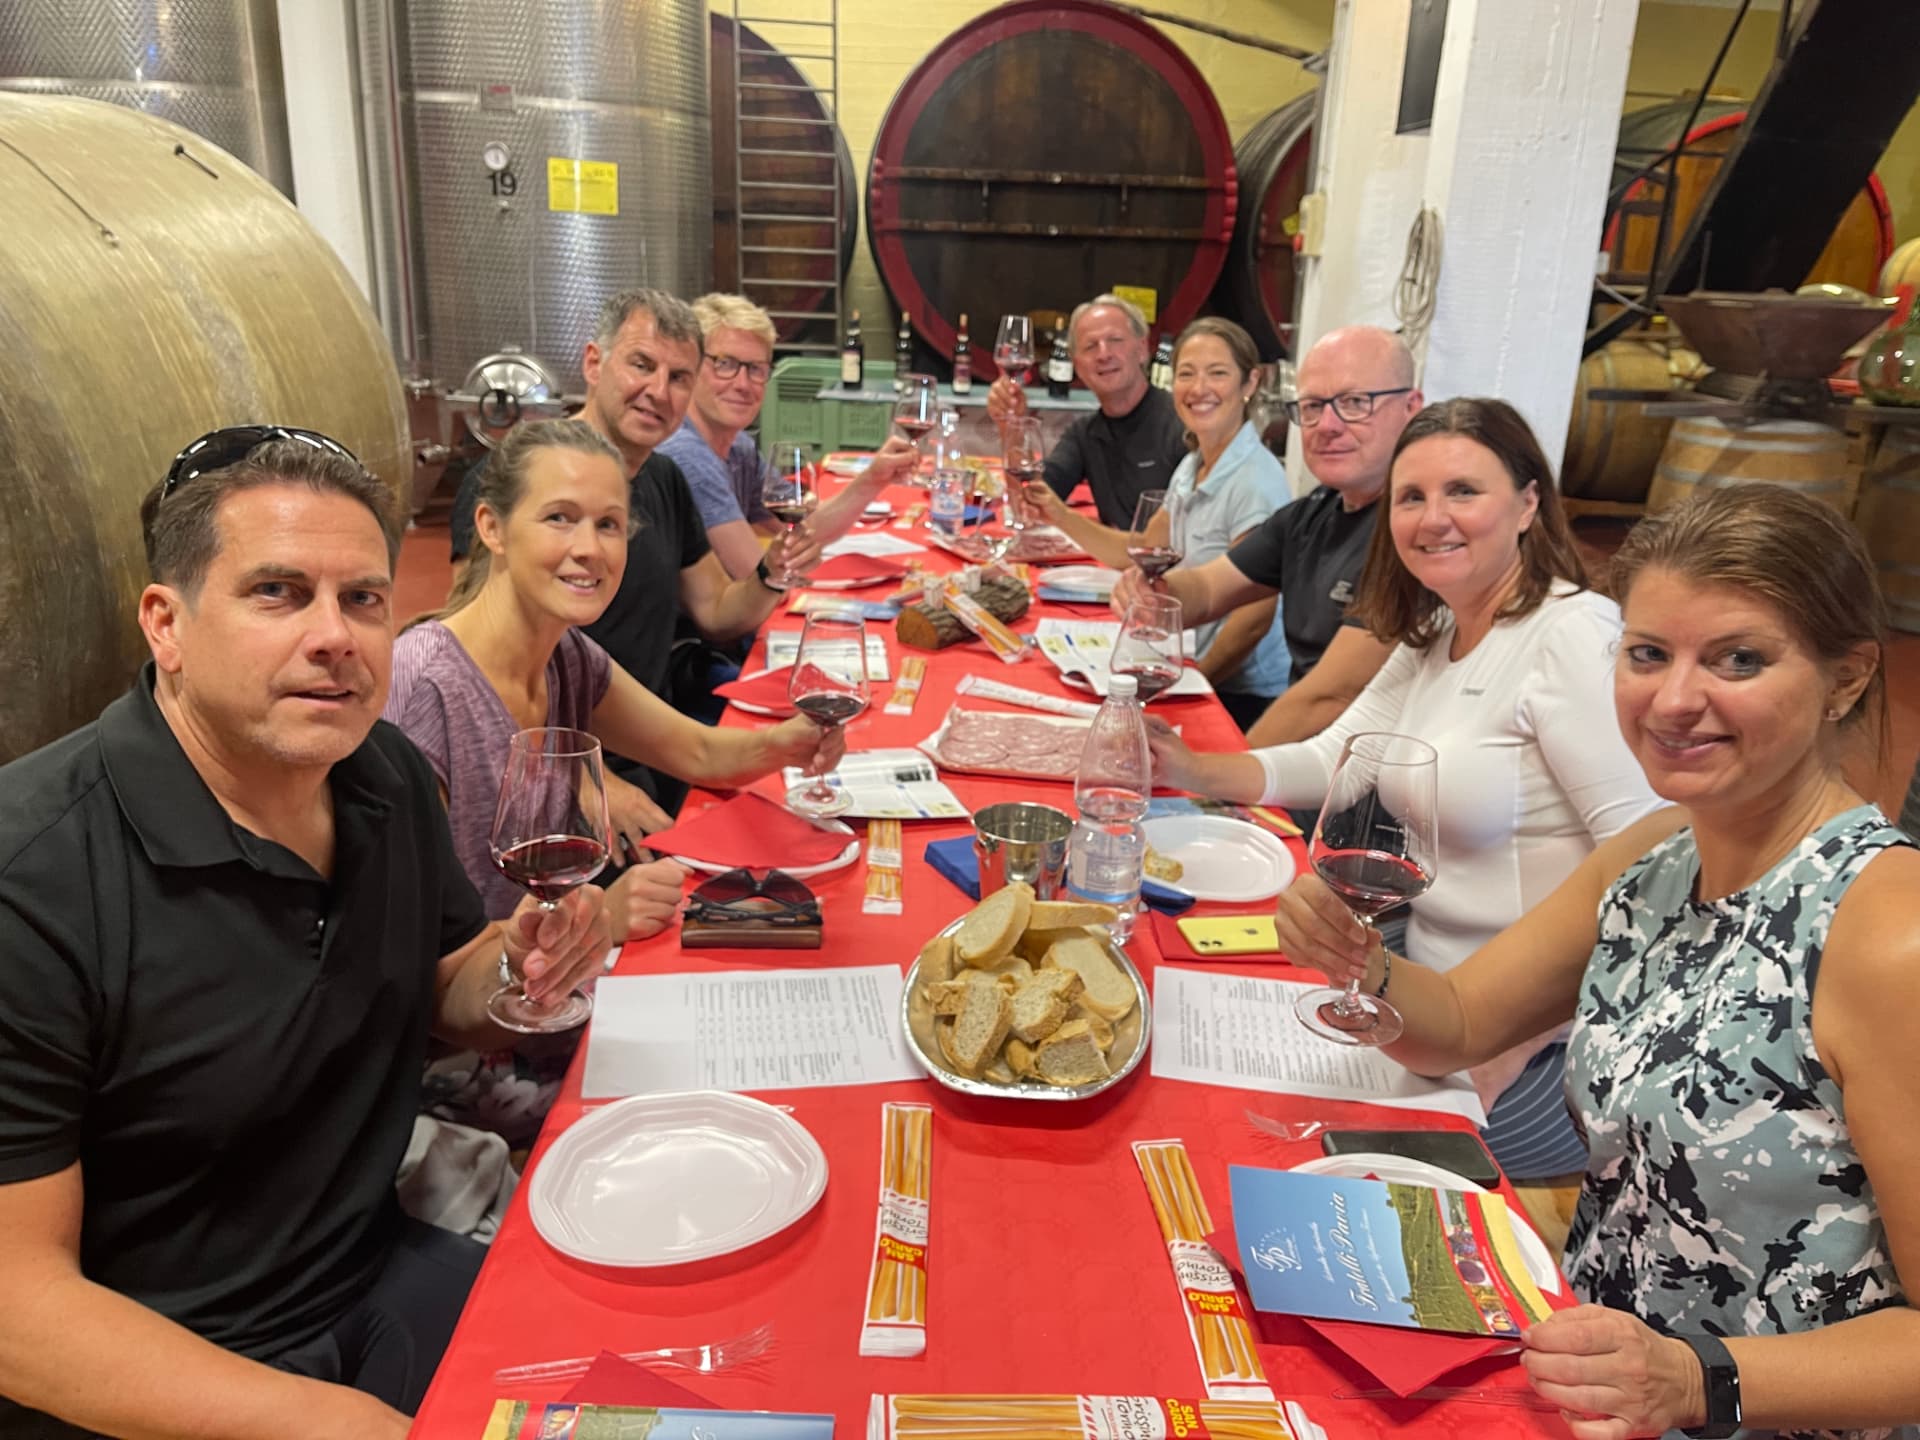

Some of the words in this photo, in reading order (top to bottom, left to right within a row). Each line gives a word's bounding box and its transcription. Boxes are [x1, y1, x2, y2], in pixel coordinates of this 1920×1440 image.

[487, 171, 516, 196] 19
[1329, 1191, 1354, 1253] Pavia
[880, 1238, 923, 1256] CARLO
[886, 1246, 915, 1262] SAN
[1177, 1261, 1227, 1274] Torino
[1188, 1292, 1235, 1305] CARLO
[1199, 1301, 1230, 1312] SAN
[1166, 1398, 1188, 1438] CARLO
[1180, 1405, 1199, 1429] SAN
